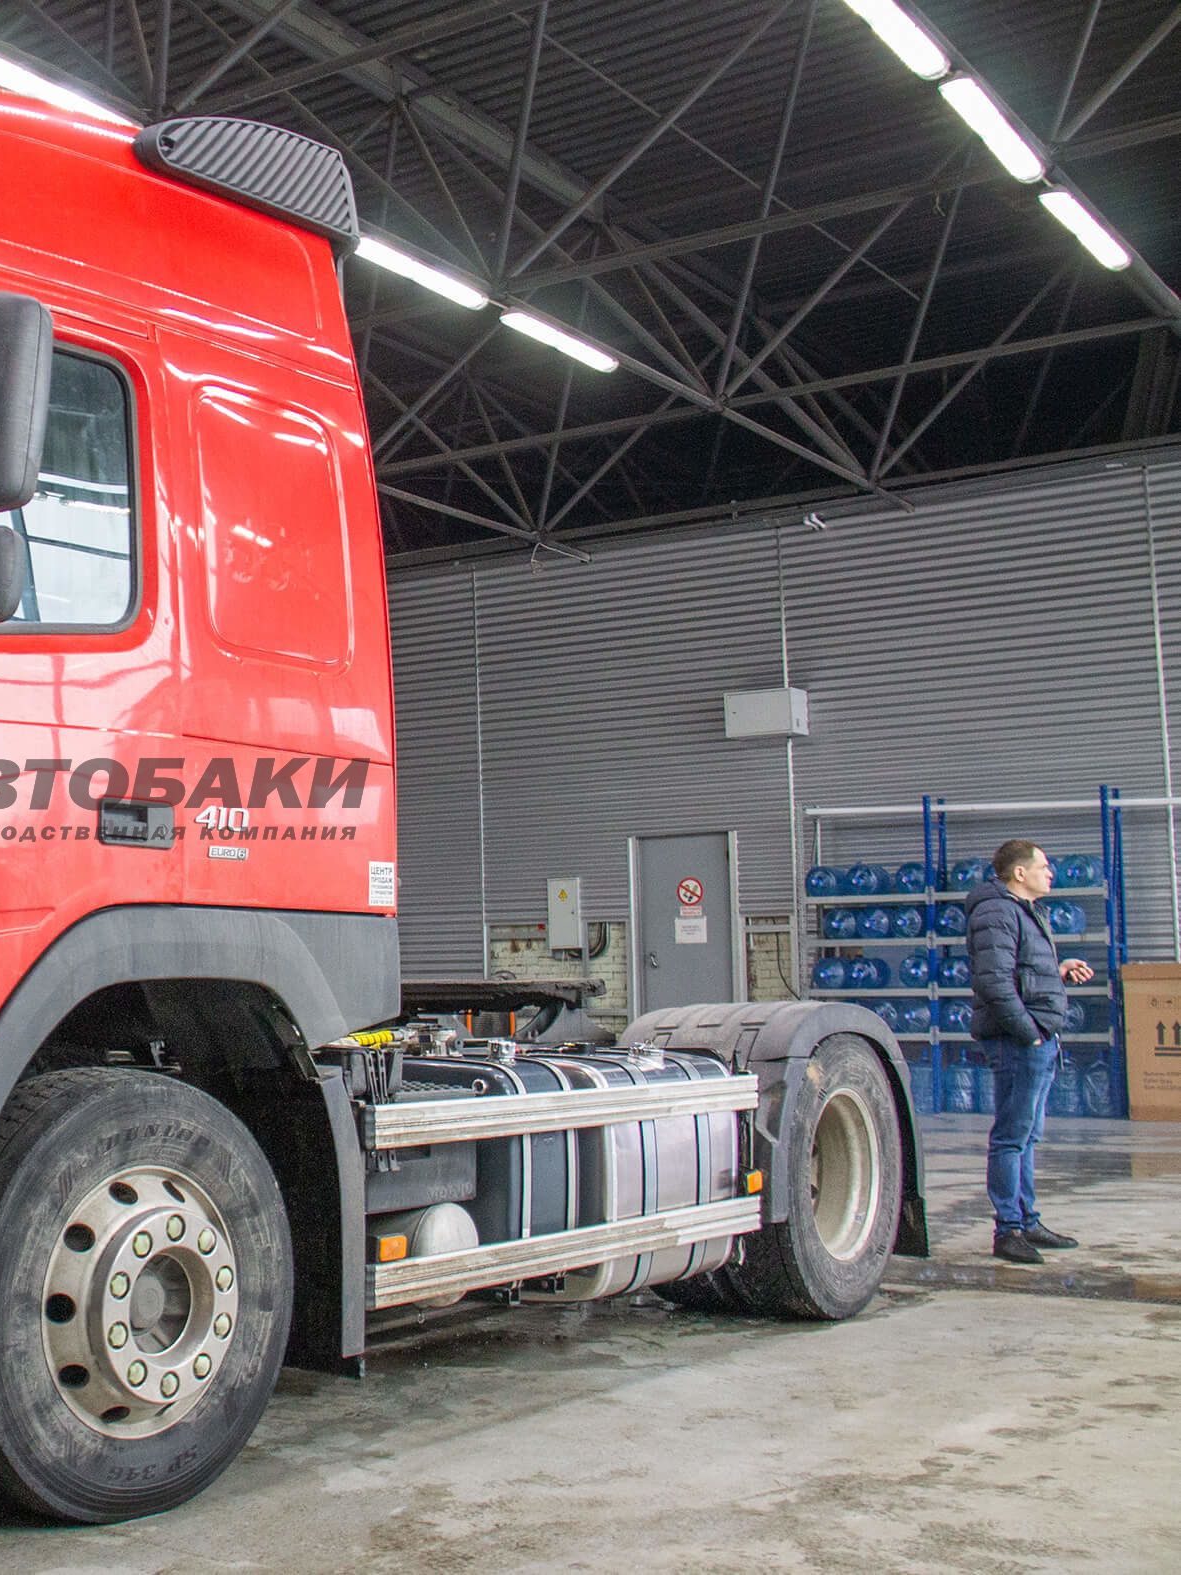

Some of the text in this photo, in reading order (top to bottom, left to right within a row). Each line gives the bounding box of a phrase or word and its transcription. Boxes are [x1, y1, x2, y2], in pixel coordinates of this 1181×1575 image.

[194, 804, 250, 832] 410
[370, 865, 393, 876] ЦЕНТР
[100, 1120, 212, 1154] DUNLOP
